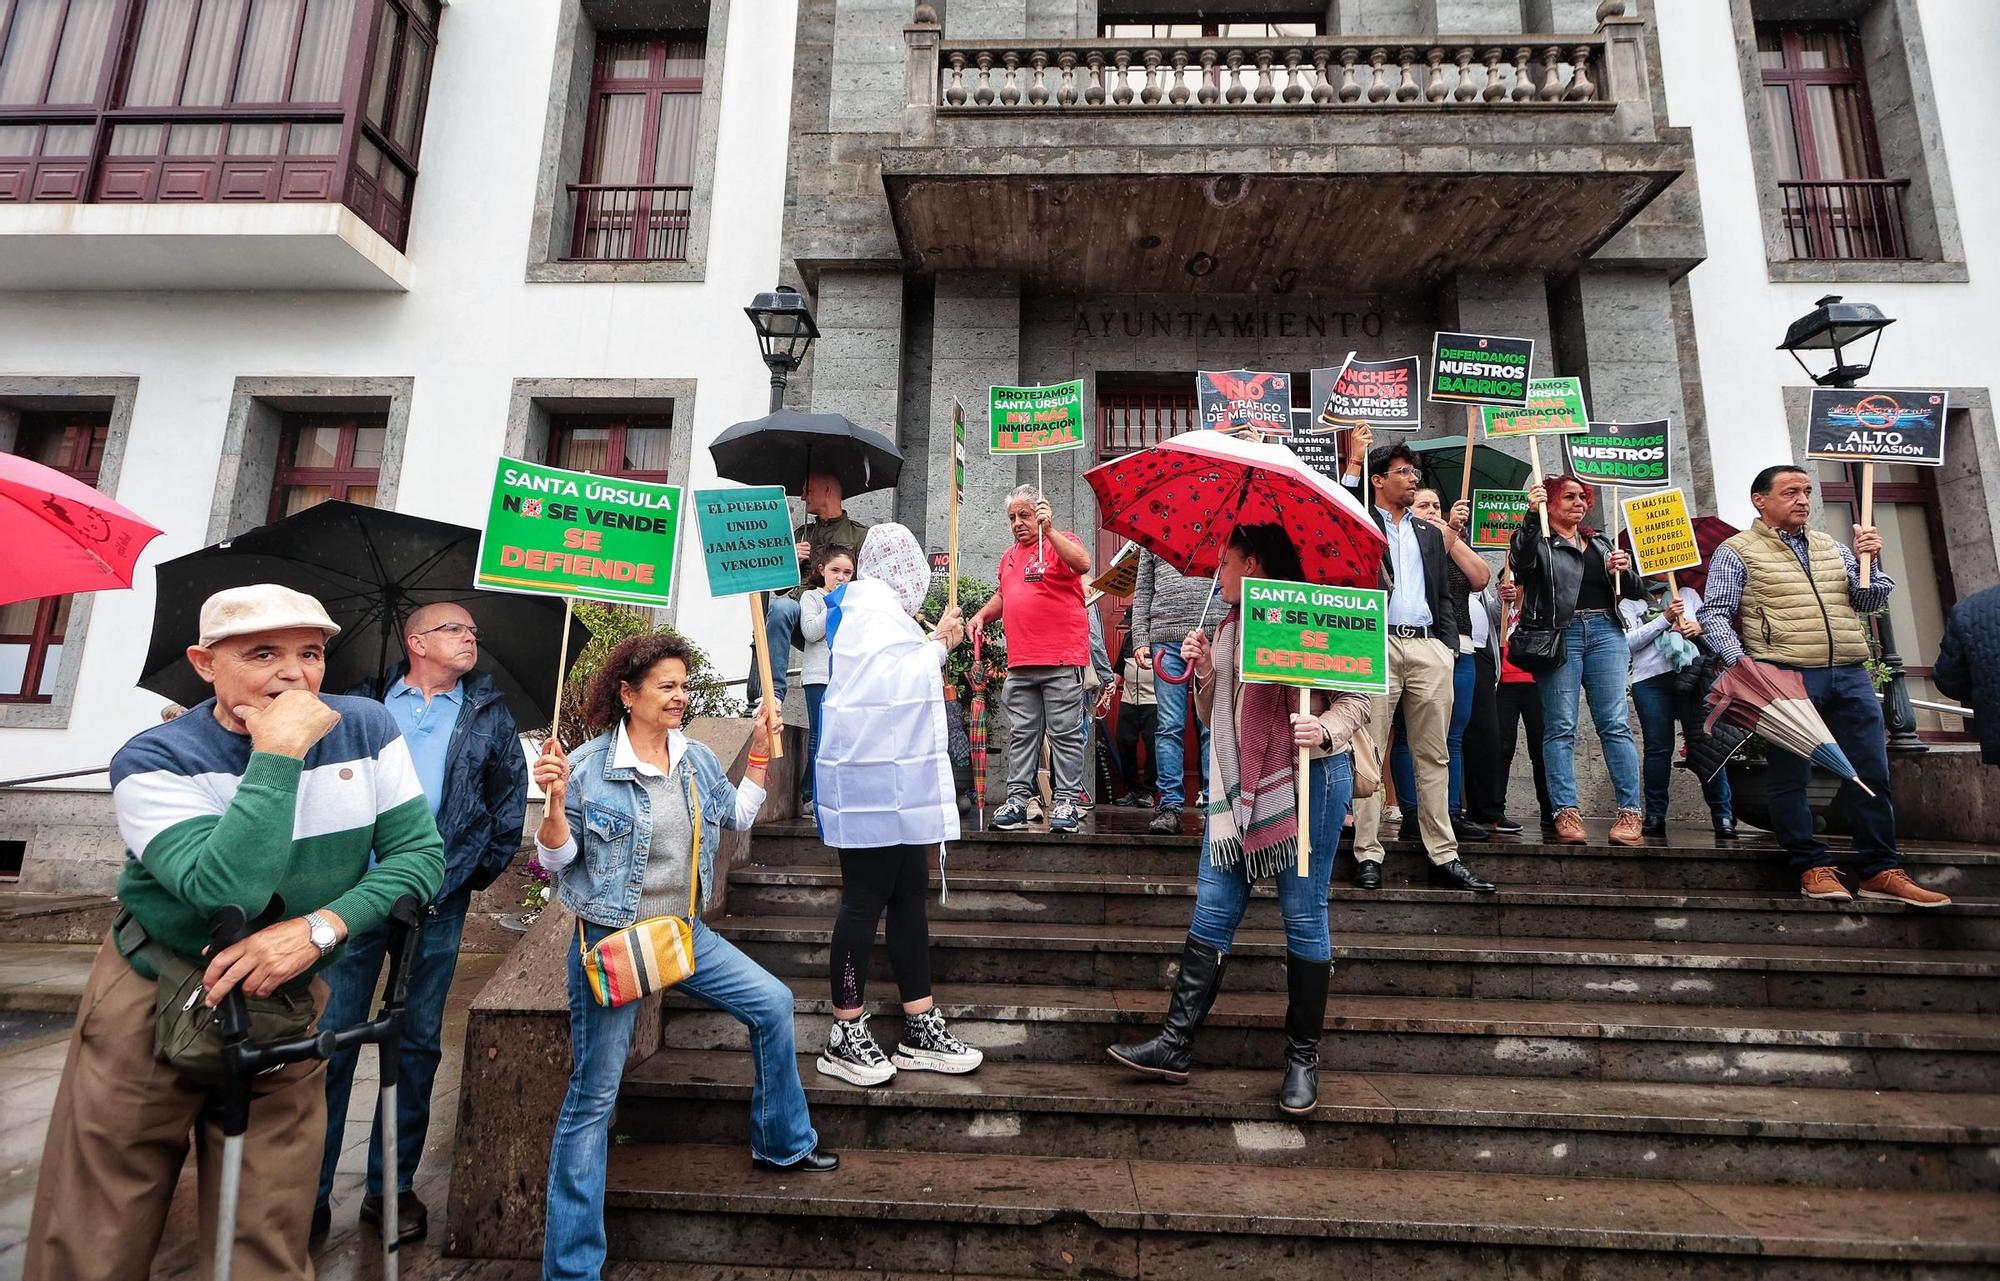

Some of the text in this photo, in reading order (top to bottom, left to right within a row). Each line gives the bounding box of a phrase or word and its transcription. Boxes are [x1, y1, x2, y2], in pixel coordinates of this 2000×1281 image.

[1074, 311, 1385, 339] AYUNTAMIENTO
[1440, 348, 1527, 364] DEFENDAMOS
[1439, 360, 1525, 380] NUESTROS
[998, 386, 1075, 400] PROTEJAMOS
[1226, 380, 1265, 401] NO
[1337, 380, 1408, 397] RAIDOR
[1438, 375, 1523, 397] BARRIOS
[994, 393, 1078, 410] SANTA ÚRSULA
[1209, 399, 1281, 413] AL TRÁFICO
[1330, 392, 1408, 408] NOS VENDES
[1206, 409, 1287, 423] DE MENORES
[1334, 405, 1409, 417] MARRUECOS
[998, 417, 1076, 432] INMIGRACIÓN
[1494, 414, 1580, 433] ILEGAL
[998, 428, 1078, 449] ILEGAL
[1570, 434, 1664, 447] DEFENDAMOS
[1845, 430, 1903, 445] ALTO
[1572, 445, 1664, 461] NUESTROS
[1823, 442, 1924, 455] A LA INVASIÓN
[1574, 459, 1665, 478] BARRIOS
[503, 469, 672, 511] SANTA ÚRSULA
[1481, 493, 1526, 502] PROTEJA
[707, 500, 778, 515] EL PUEBLO
[1477, 502, 1511, 510] SANTA
[1632, 503, 1641, 511] ES
[1646, 508, 1671, 520] SACIAR
[547, 502, 578, 522] SE
[586, 508, 667, 535] VENDE
[726, 519, 768, 533] UNIDO
[1480, 522, 1522, 530] INMIGRA
[1634, 516, 1686, 535] EL HAMBRE DE
[563, 527, 603, 553] SE
[706, 533, 792, 554] JAMÁS SERÁ
[1642, 536, 1656, 545] LOS
[1640, 540, 1695, 558] QUE LA CODICIA
[500, 545, 656, 585] DEFIENDE
[720, 555, 784, 573] VENCIDO!
[1643, 561, 1654, 570] DE
[1655, 558, 1668, 567] LOS
[1249, 587, 1379, 611] SANTA ÚRSULA
[1285, 609, 1309, 625] SE
[1312, 613, 1377, 632] VENDE
[1300, 629, 1329, 650] SE
[1255, 647, 1373, 675] DEFIENDE
